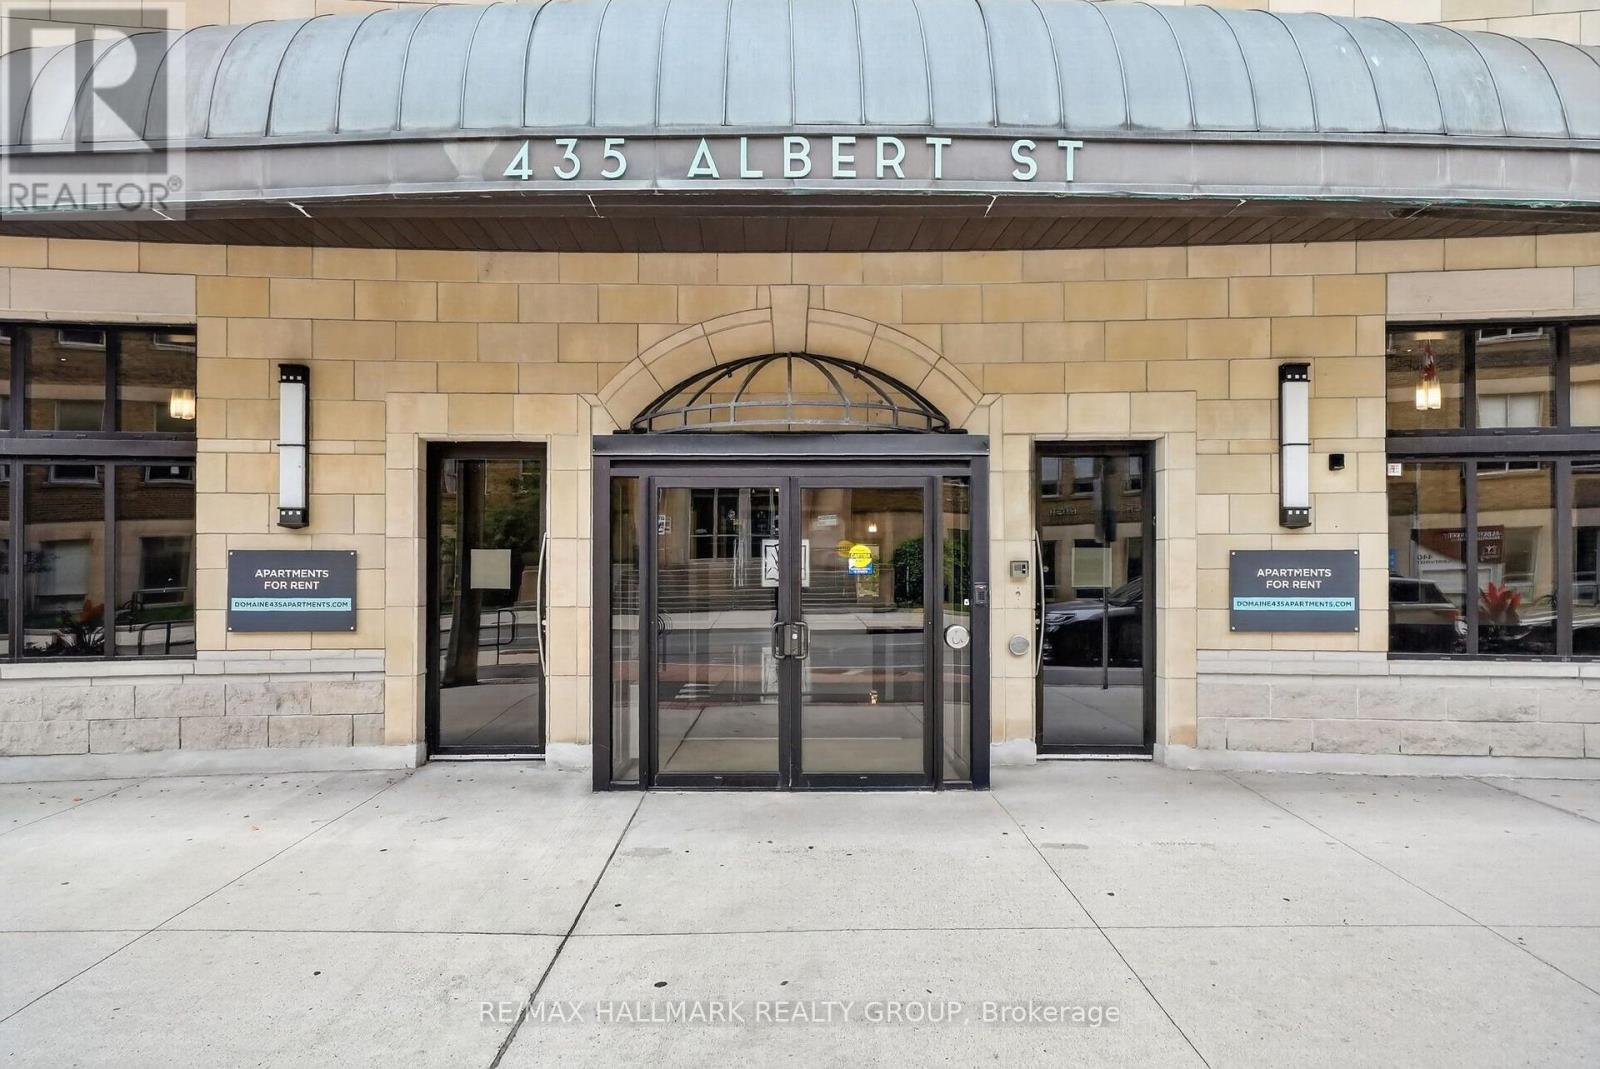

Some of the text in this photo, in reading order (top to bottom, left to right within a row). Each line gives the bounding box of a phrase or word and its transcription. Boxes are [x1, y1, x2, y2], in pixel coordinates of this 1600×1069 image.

[502, 135, 1084, 182] 435 ALBERT ST
[254, 569, 329, 578] APARTMENTS
[1256, 568, 1332, 578] APARTMENTS
[264, 581, 320, 590] FOR RENT
[1265, 580, 1322, 589] FOR RENT
[1236, 600, 1352, 608] DOMAINE435APARTMENTS.COM
